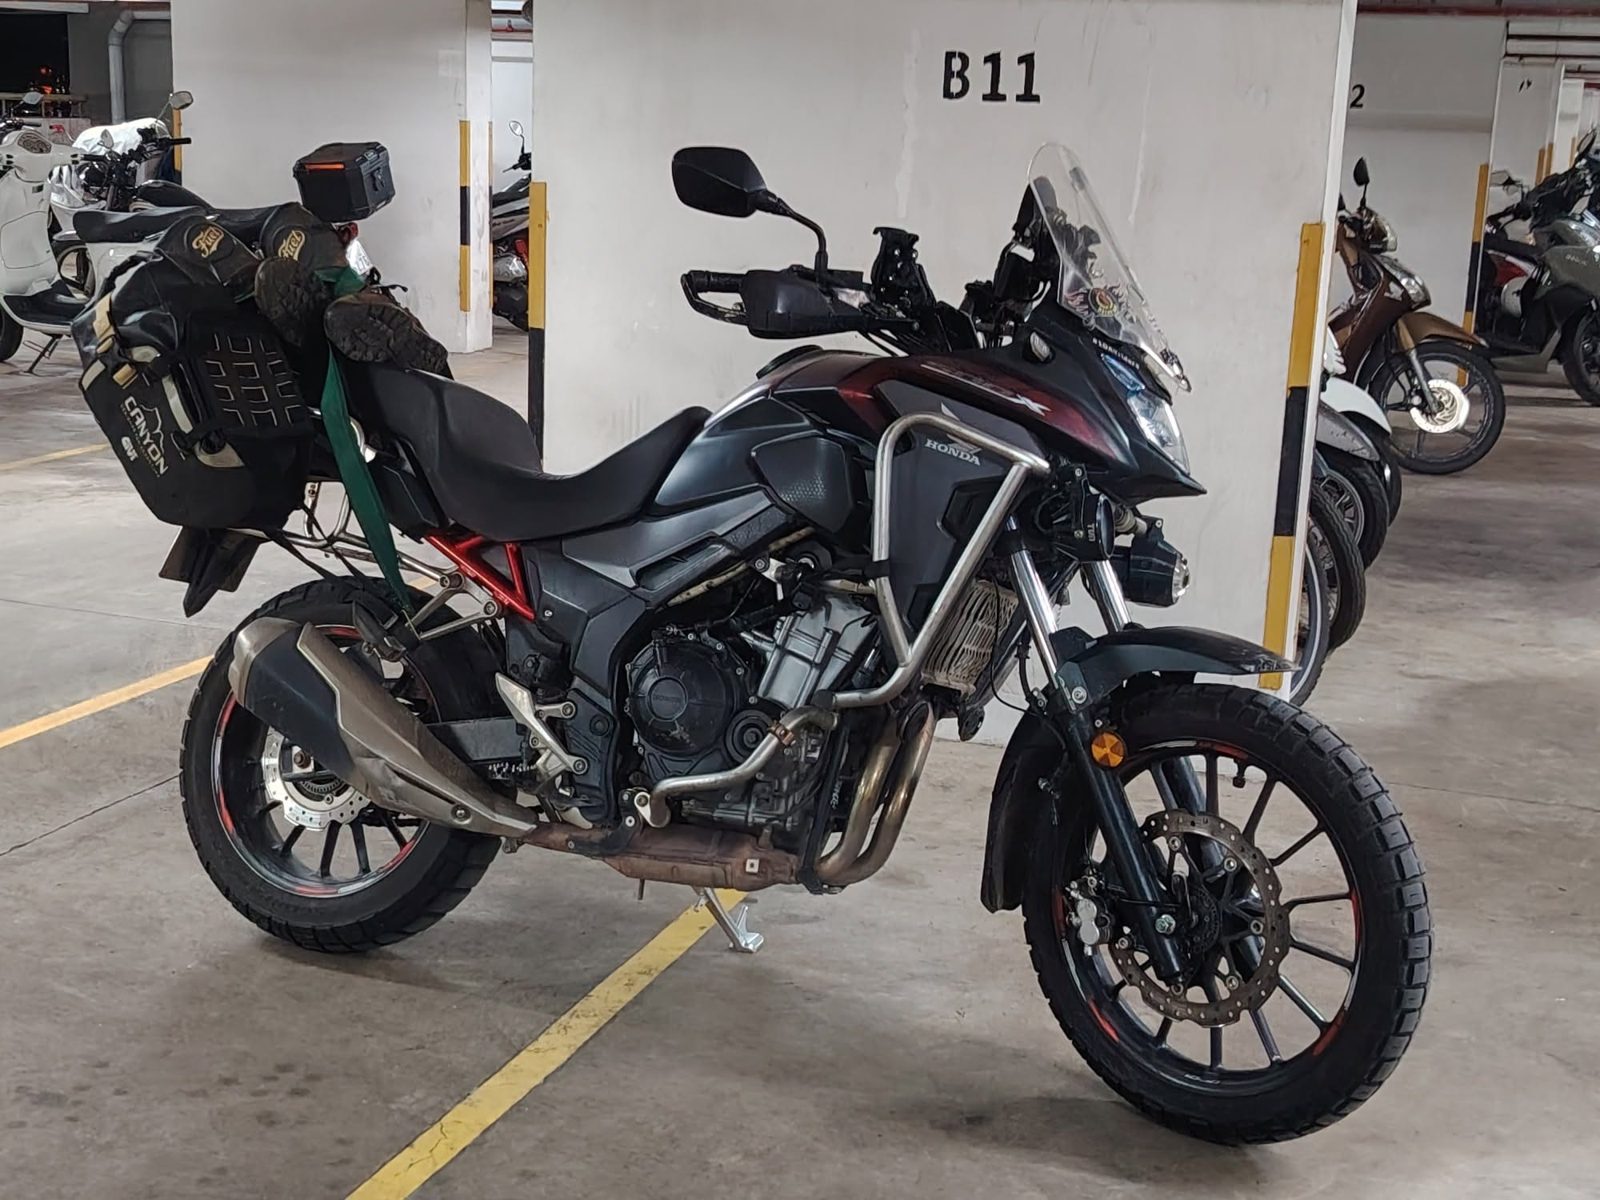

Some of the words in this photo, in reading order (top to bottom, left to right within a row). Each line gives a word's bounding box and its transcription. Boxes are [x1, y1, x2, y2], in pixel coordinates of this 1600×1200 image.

[943, 50, 1040, 103] B11
[192, 226, 224, 258] Fuel
[124, 396, 169, 475] CANYON
[924, 438, 981, 466] HONDA
